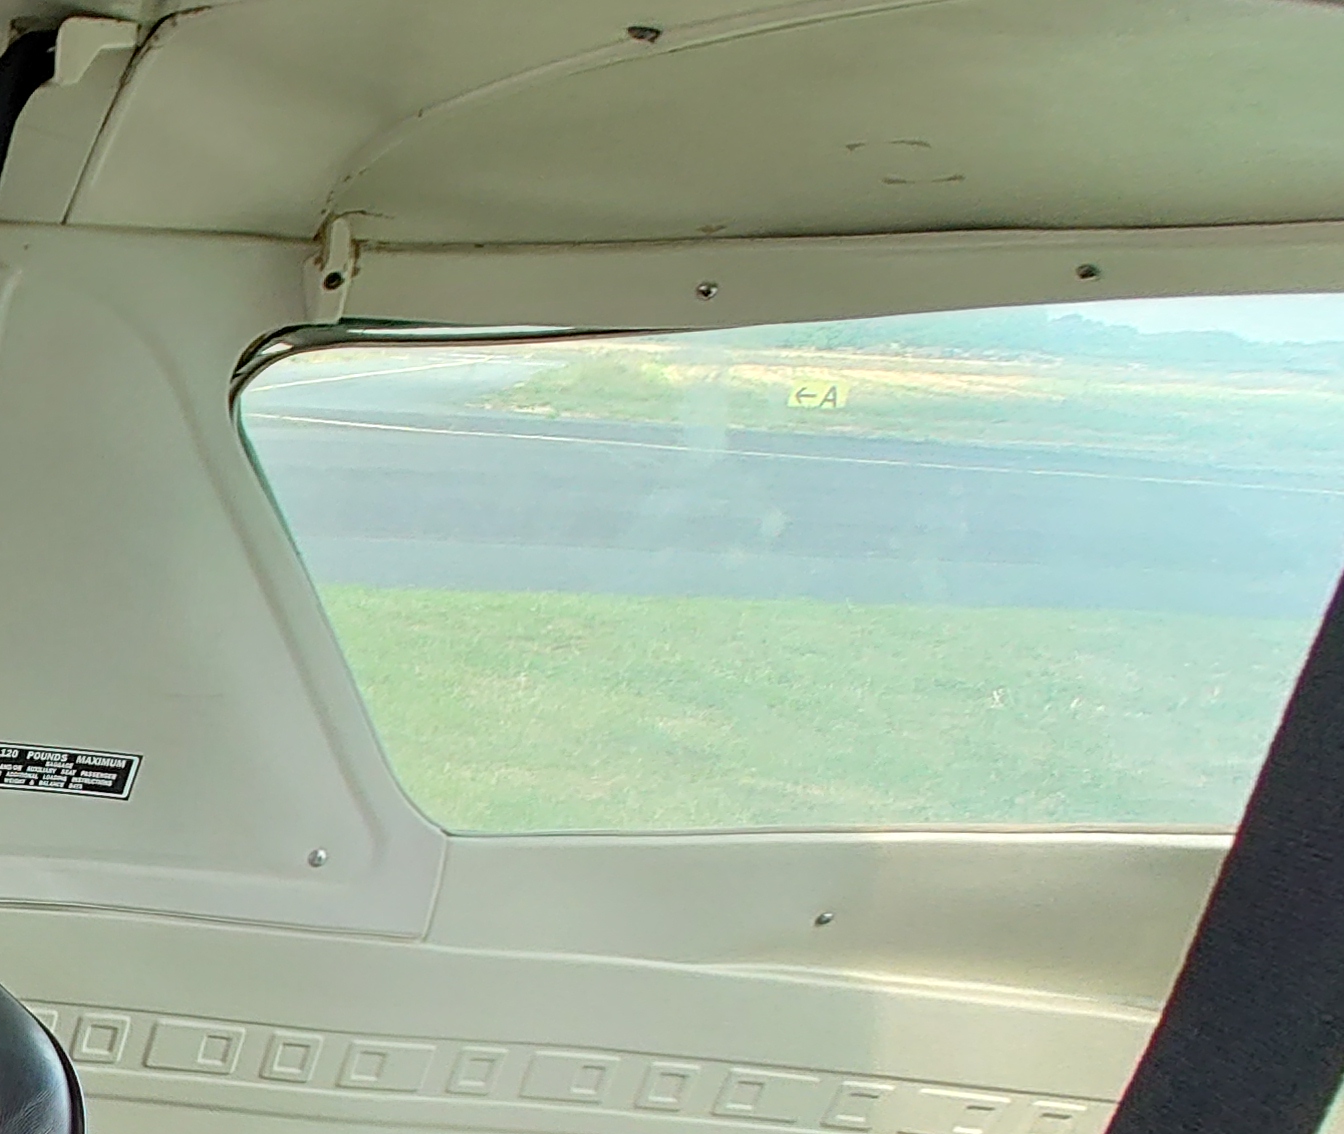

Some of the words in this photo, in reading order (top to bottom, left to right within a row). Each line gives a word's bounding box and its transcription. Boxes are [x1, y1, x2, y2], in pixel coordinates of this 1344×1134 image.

[819, 385, 838, 408] A
[0, 748, 19, 759] 120
[26, 750, 68, 762] POUNDS
[75, 755, 127, 769] MAXIMUM
